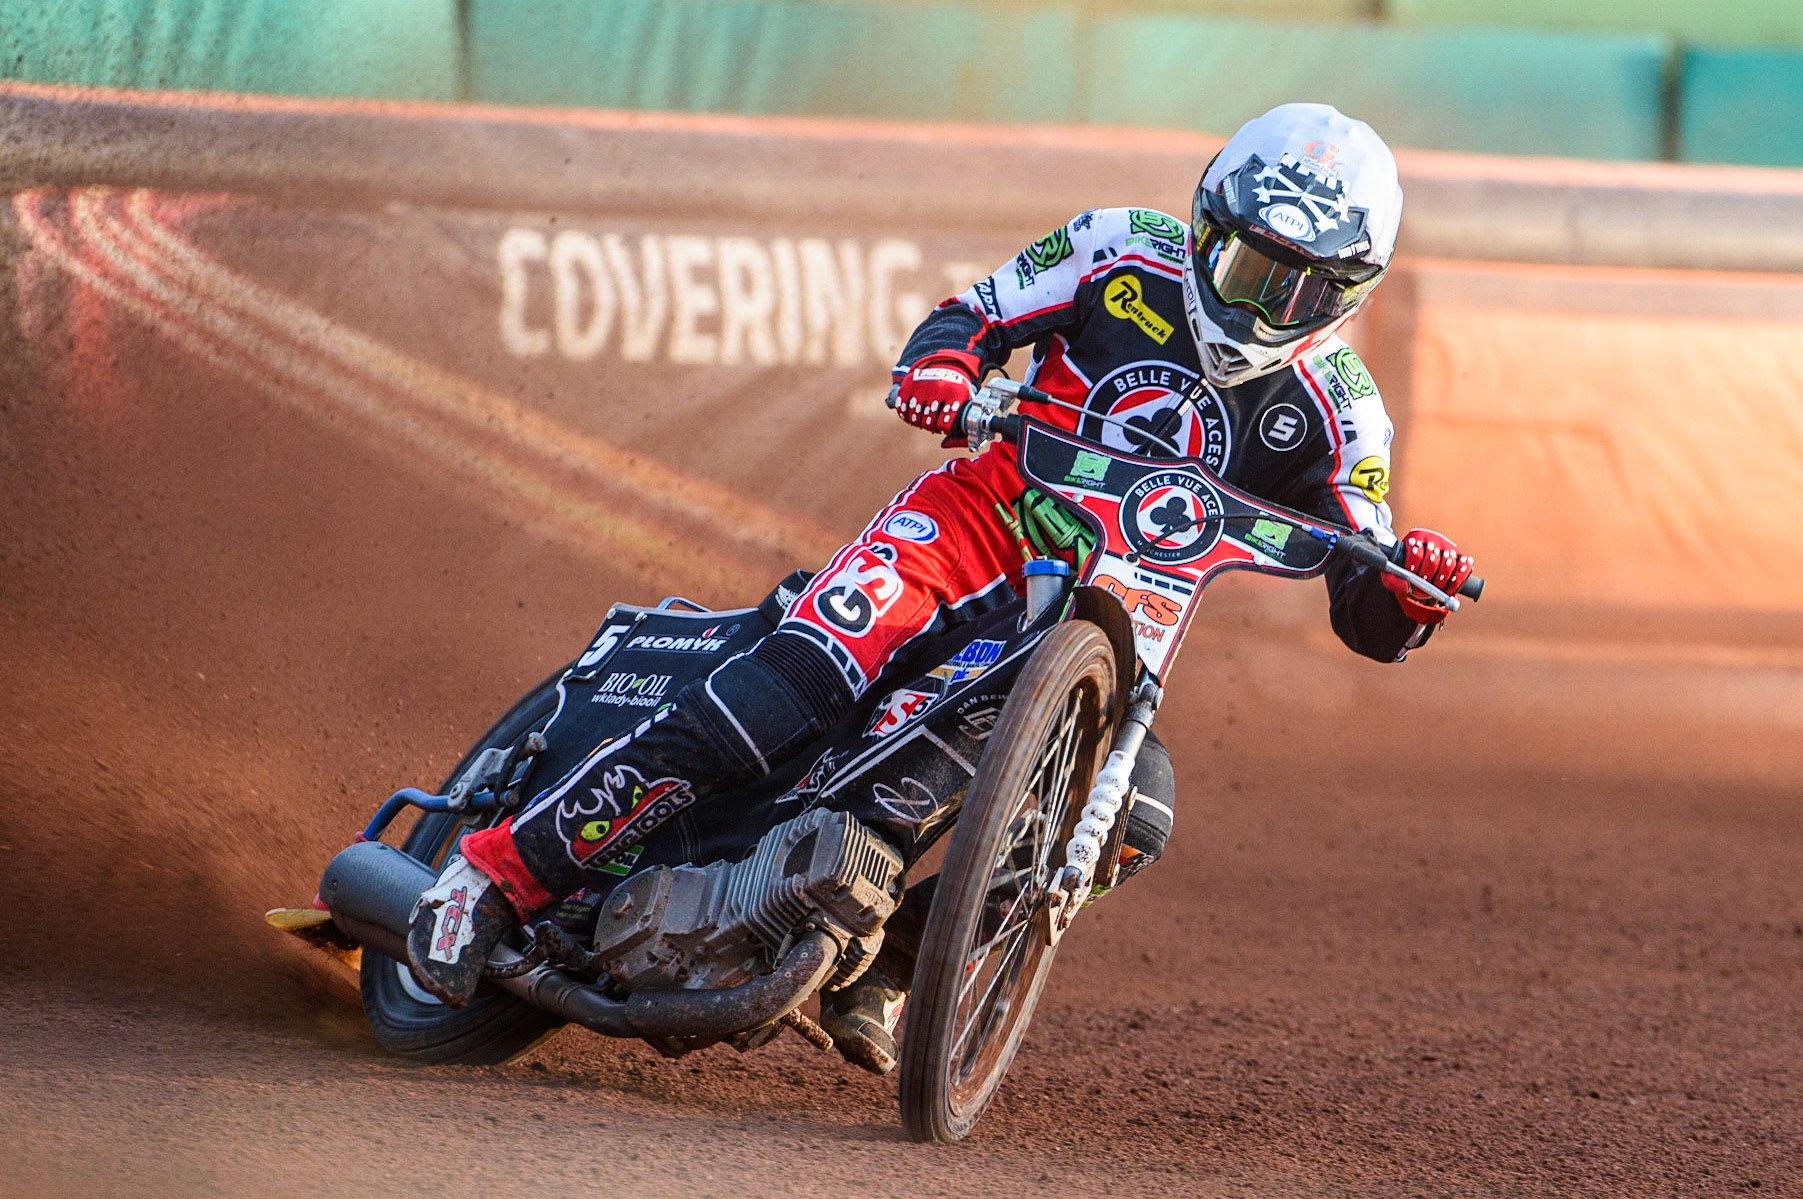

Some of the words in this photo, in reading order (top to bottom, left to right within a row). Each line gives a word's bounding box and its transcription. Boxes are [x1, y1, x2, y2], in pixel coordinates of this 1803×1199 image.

[1272, 211, 1304, 231] ATPI
[1125, 237, 1187, 259] BIKERIGHT
[499, 229, 926, 365] COVERING
[1110, 280, 1167, 339] Rentruck
[1312, 354, 1353, 410] BIKERIGHT
[1113, 369, 1172, 393] BELLE
[1181, 377, 1212, 411] VUE
[1205, 417, 1223, 467] ACES
[1134, 475, 1171, 498] BELLE
[1177, 475, 1203, 492] VUE
[1201, 494, 1219, 521] ACE
[893, 516, 928, 534] ATPI
[1244, 532, 1287, 558] BIKERIGHT
[577, 624, 632, 669] 5
[957, 696, 979, 715] DAN
[436, 885, 468, 961] TCX
